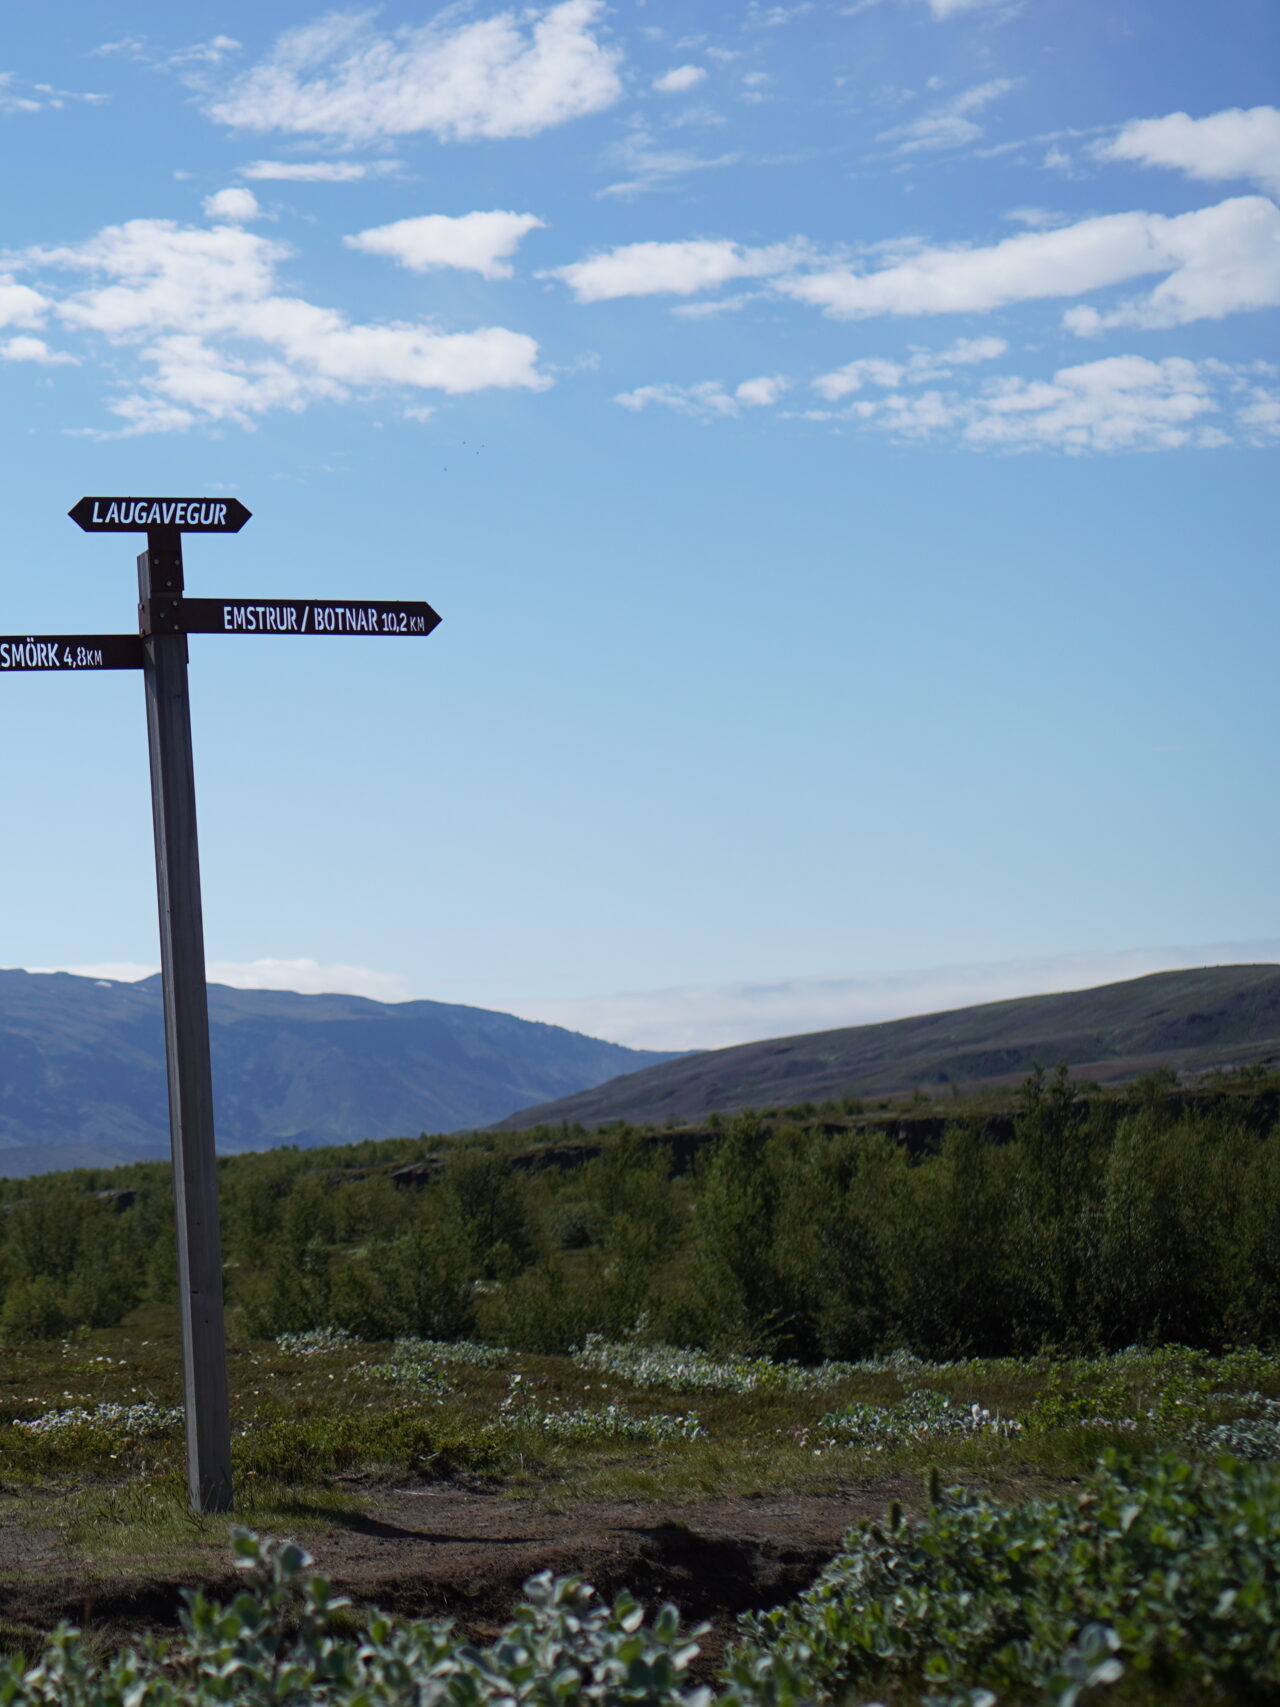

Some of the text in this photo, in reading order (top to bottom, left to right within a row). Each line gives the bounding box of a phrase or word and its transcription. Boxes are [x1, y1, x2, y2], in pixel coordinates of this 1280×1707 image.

[92, 501, 228, 525] LAUGAVEGUR
[223, 606, 298, 631] EMSTRUR
[314, 607, 379, 632] BOTNAR
[381, 612, 408, 633] 10,2
